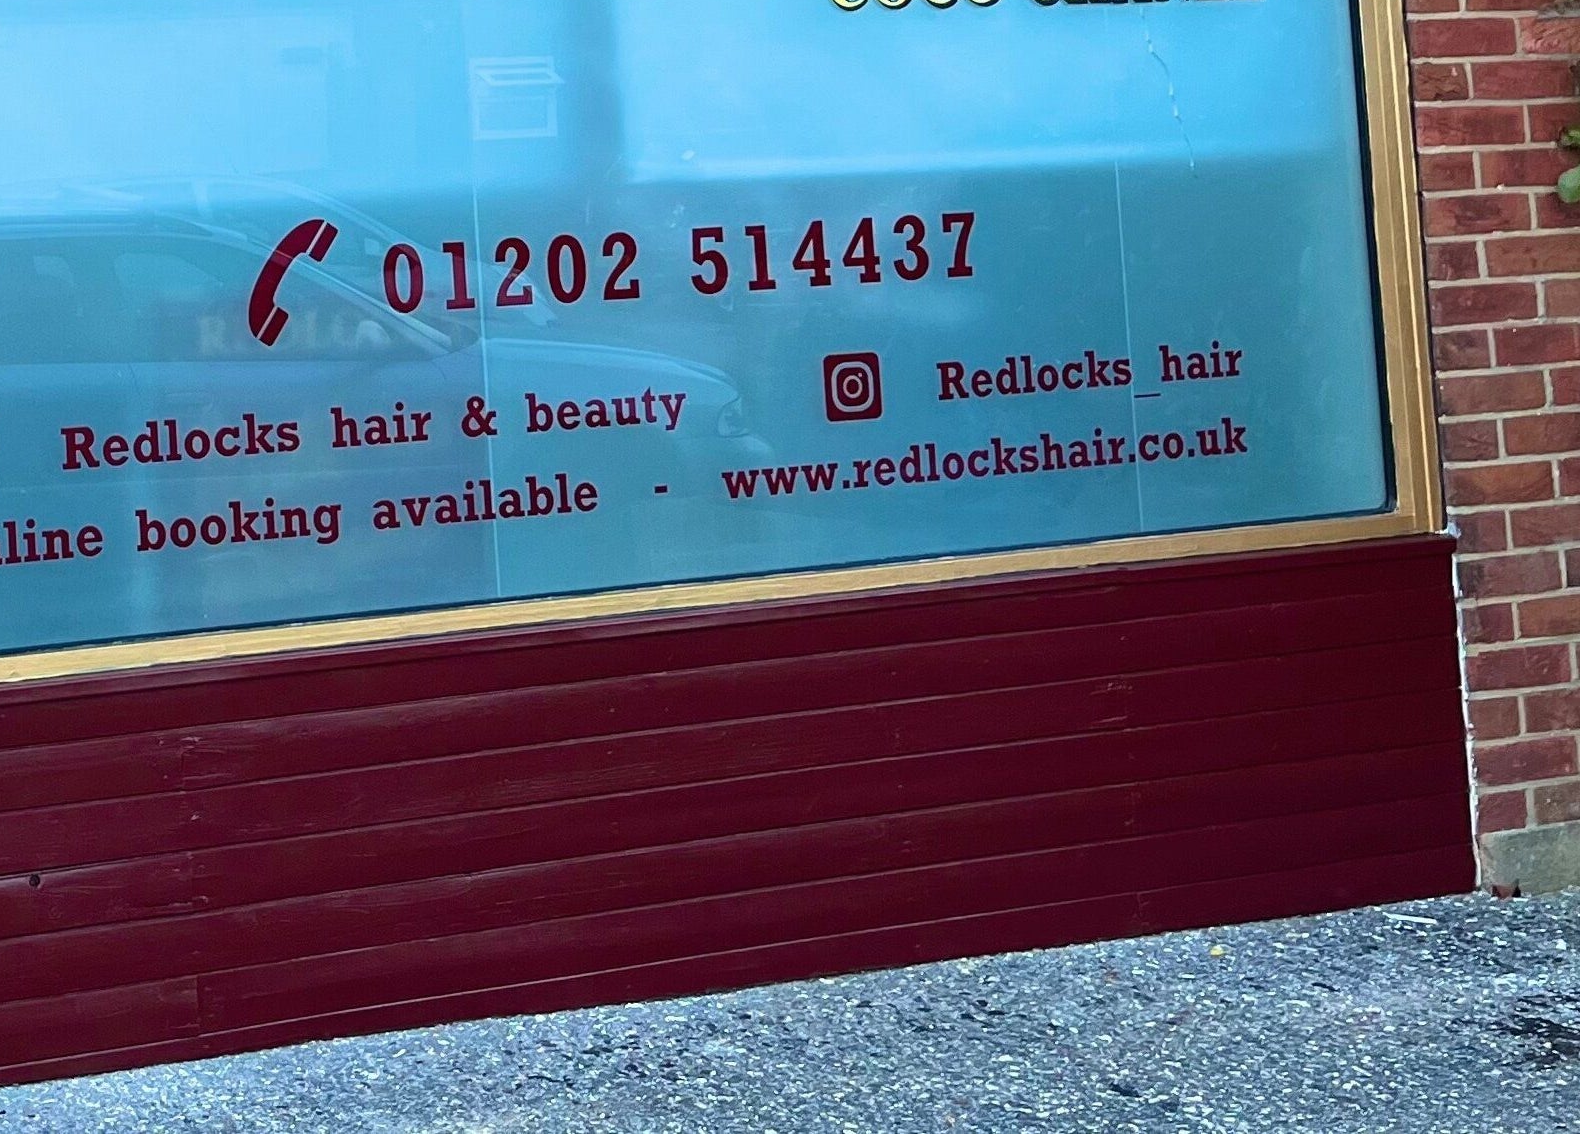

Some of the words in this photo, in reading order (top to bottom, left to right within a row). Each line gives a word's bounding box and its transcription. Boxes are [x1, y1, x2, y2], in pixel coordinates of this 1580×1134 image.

[383, 232, 641, 314] 01202
[691, 212, 976, 295] 514437
[61, 414, 300, 471] Redlocks
[330, 402, 432, 449] hair
[460, 395, 498, 438] &
[525, 387, 687, 436] beauty
[135, 497, 342, 554] booking
[372, 472, 598, 530] available
[722, 417, 1249, 499] www.redlockshair.co.uk
